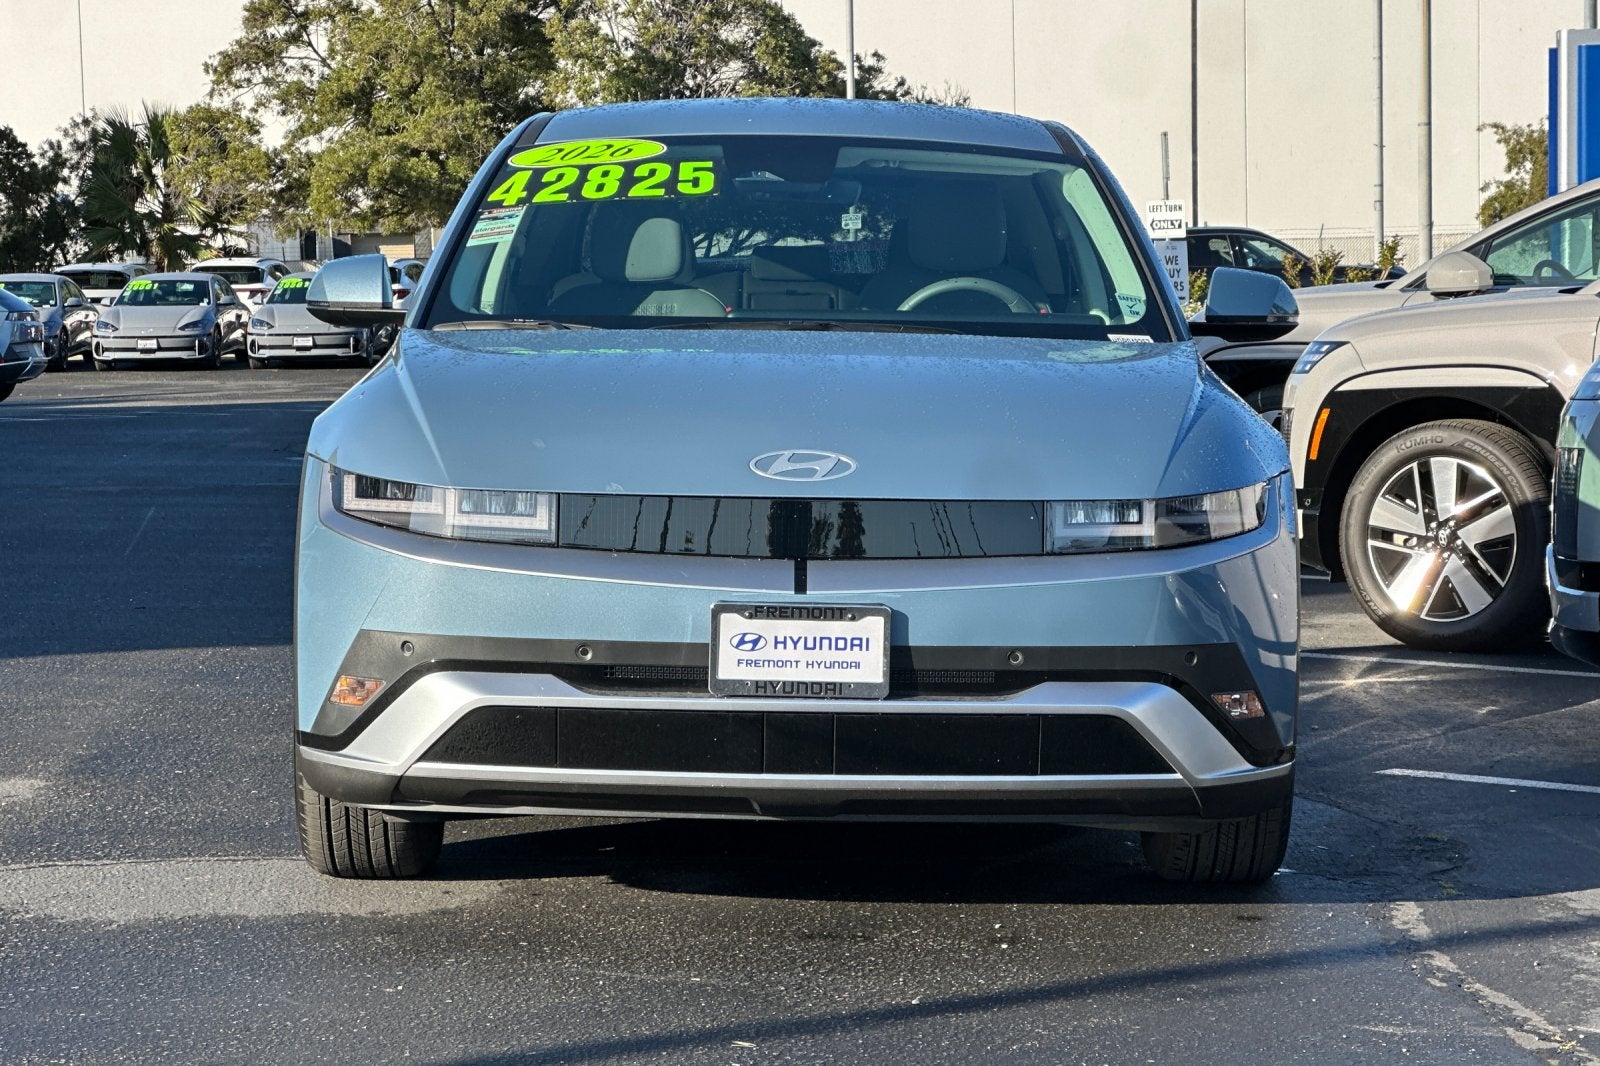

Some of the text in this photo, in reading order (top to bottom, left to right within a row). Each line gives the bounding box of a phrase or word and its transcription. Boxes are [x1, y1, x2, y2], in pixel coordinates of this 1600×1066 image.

[532, 142, 641, 165] 2026
[487, 161, 715, 206] 42825
[1148, 203, 1183, 213] LEFT TURN
[1152, 219, 1181, 230] ONLY
[1164, 254, 1180, 266] WE
[1166, 268, 1181, 279] UY
[1173, 281, 1185, 292] RS
[1394, 435, 1445, 454] KUMHO
[754, 605, 848, 620] FREMONT
[773, 635, 870, 652] HYUNDAI
[736, 658, 861, 670] FREMONT HYUNDAI
[755, 681, 843, 696] HYUNDAI
